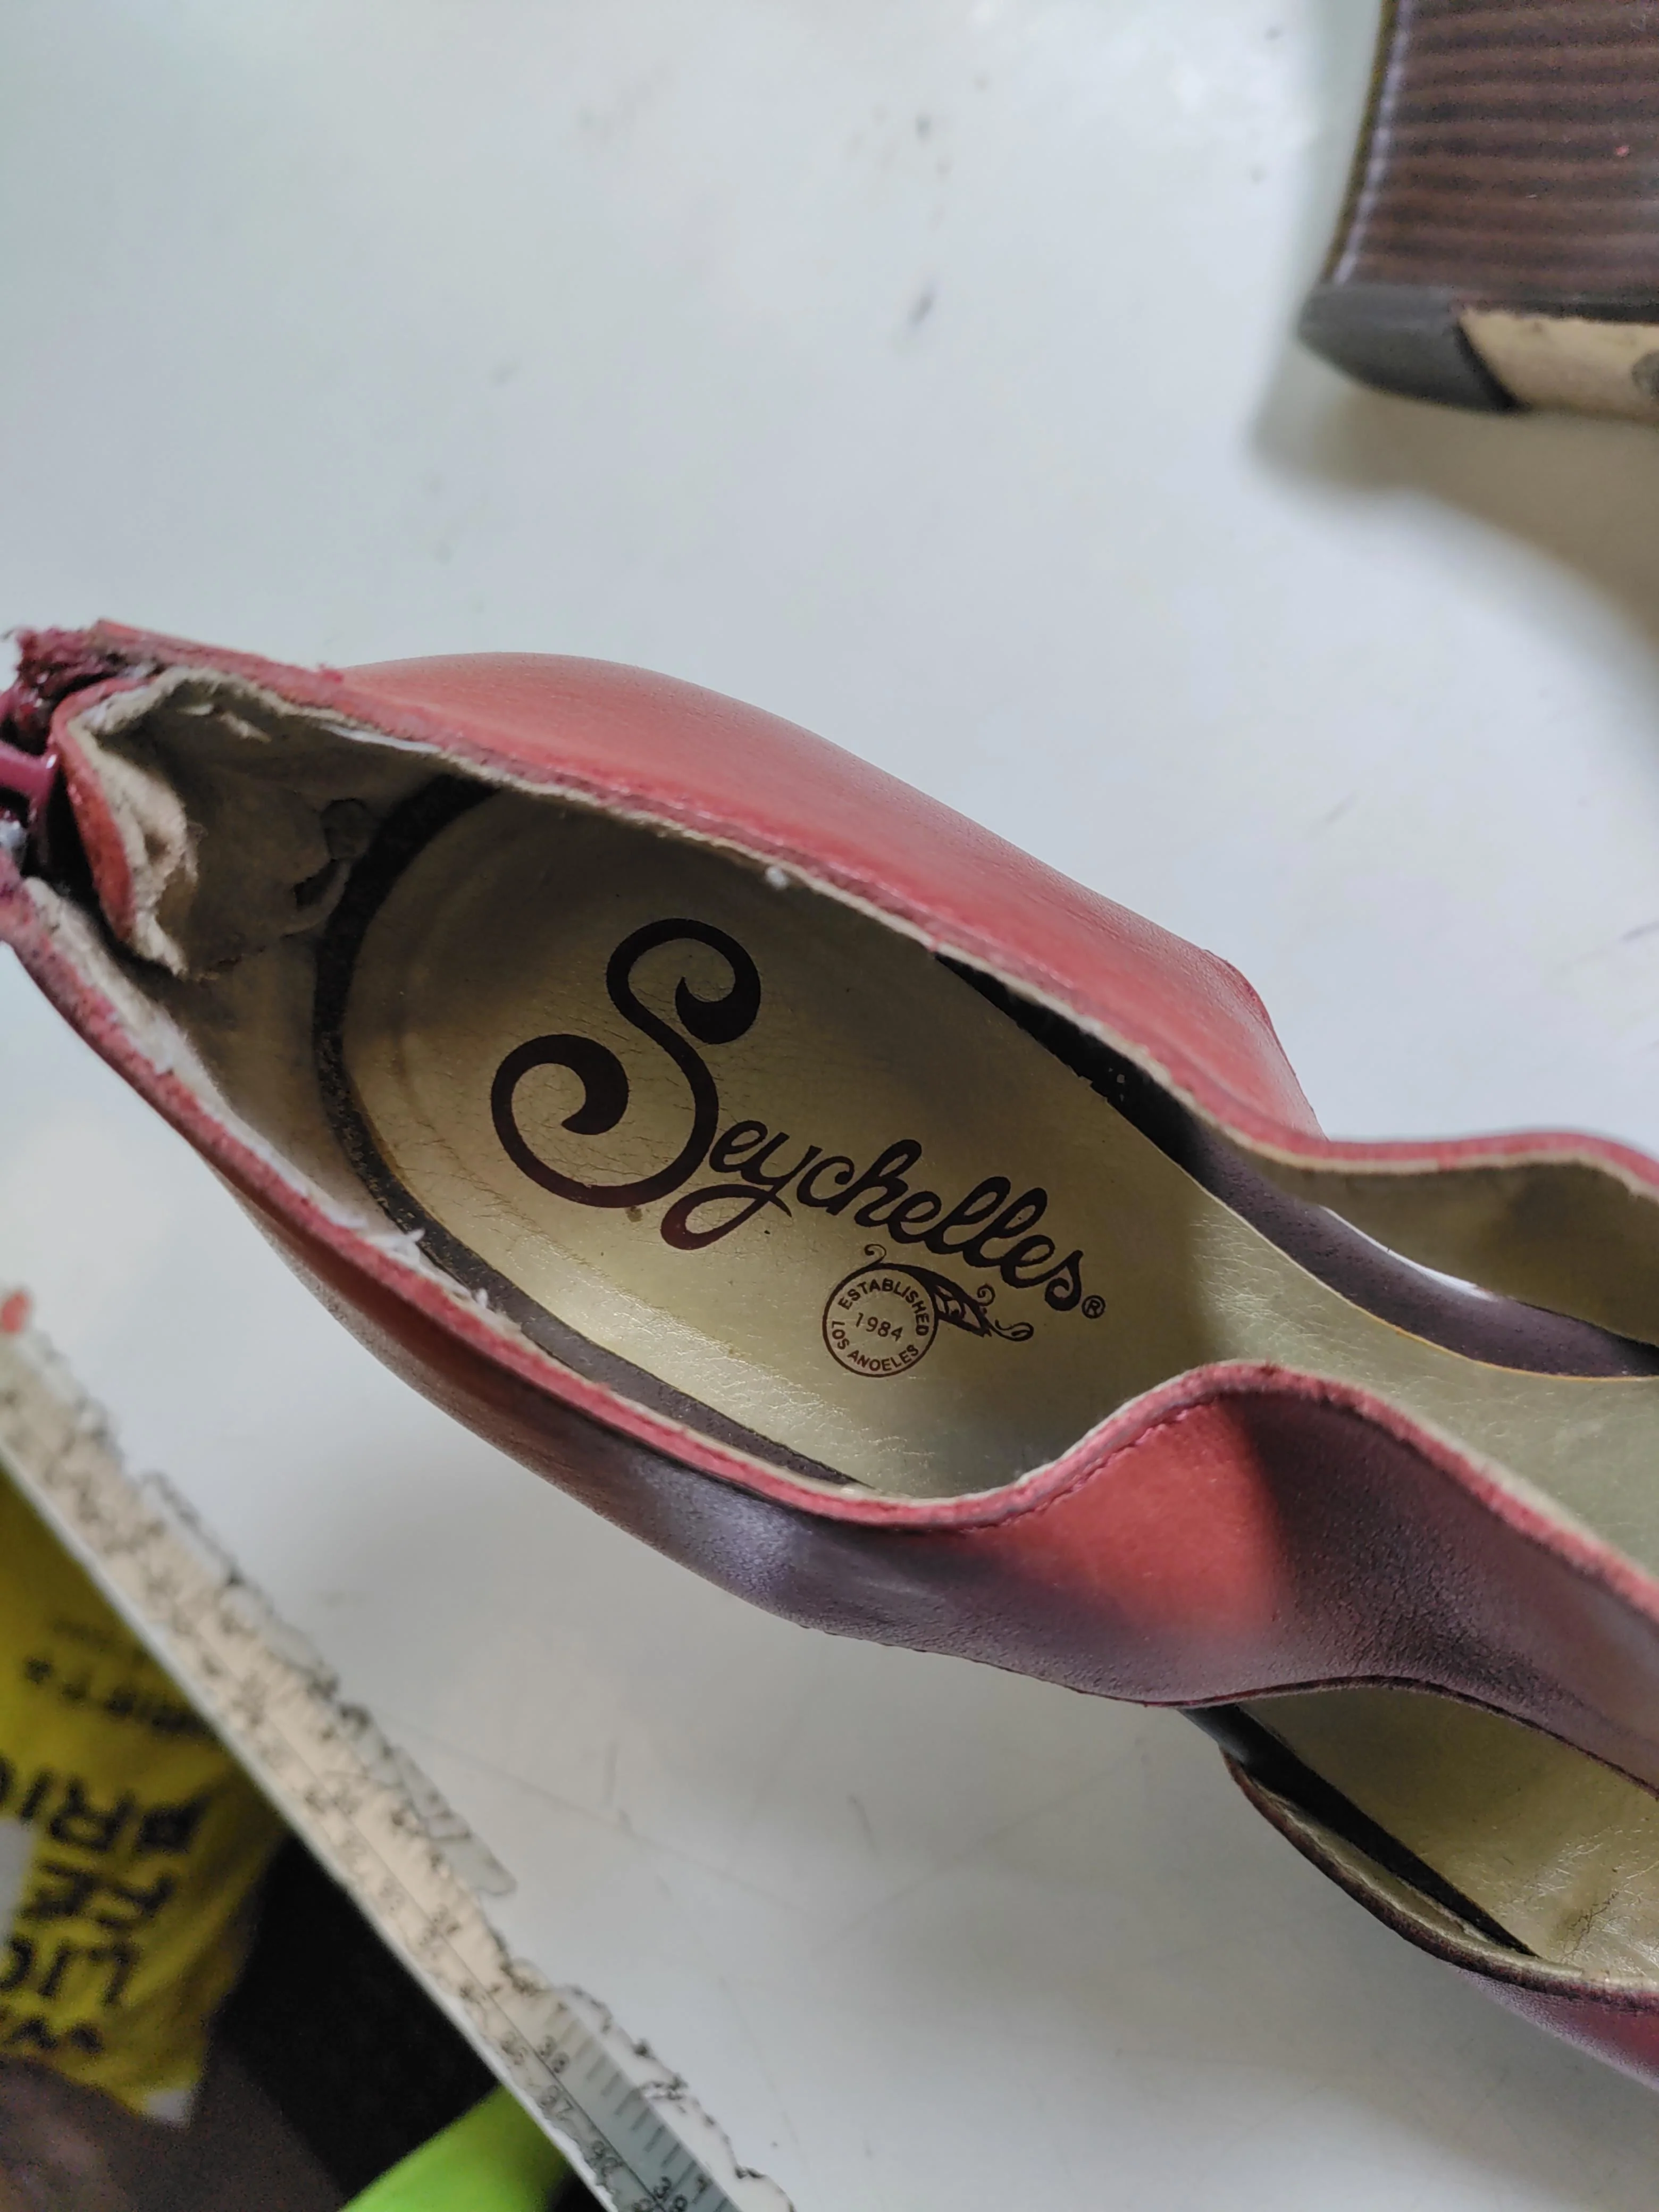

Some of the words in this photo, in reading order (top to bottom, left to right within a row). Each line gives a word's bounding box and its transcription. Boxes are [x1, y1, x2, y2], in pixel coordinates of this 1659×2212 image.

[838, 1277, 929, 1336] ESTABLISHED
[832, 1320, 850, 1350] LOS
[856, 1312, 903, 1341] 1984
